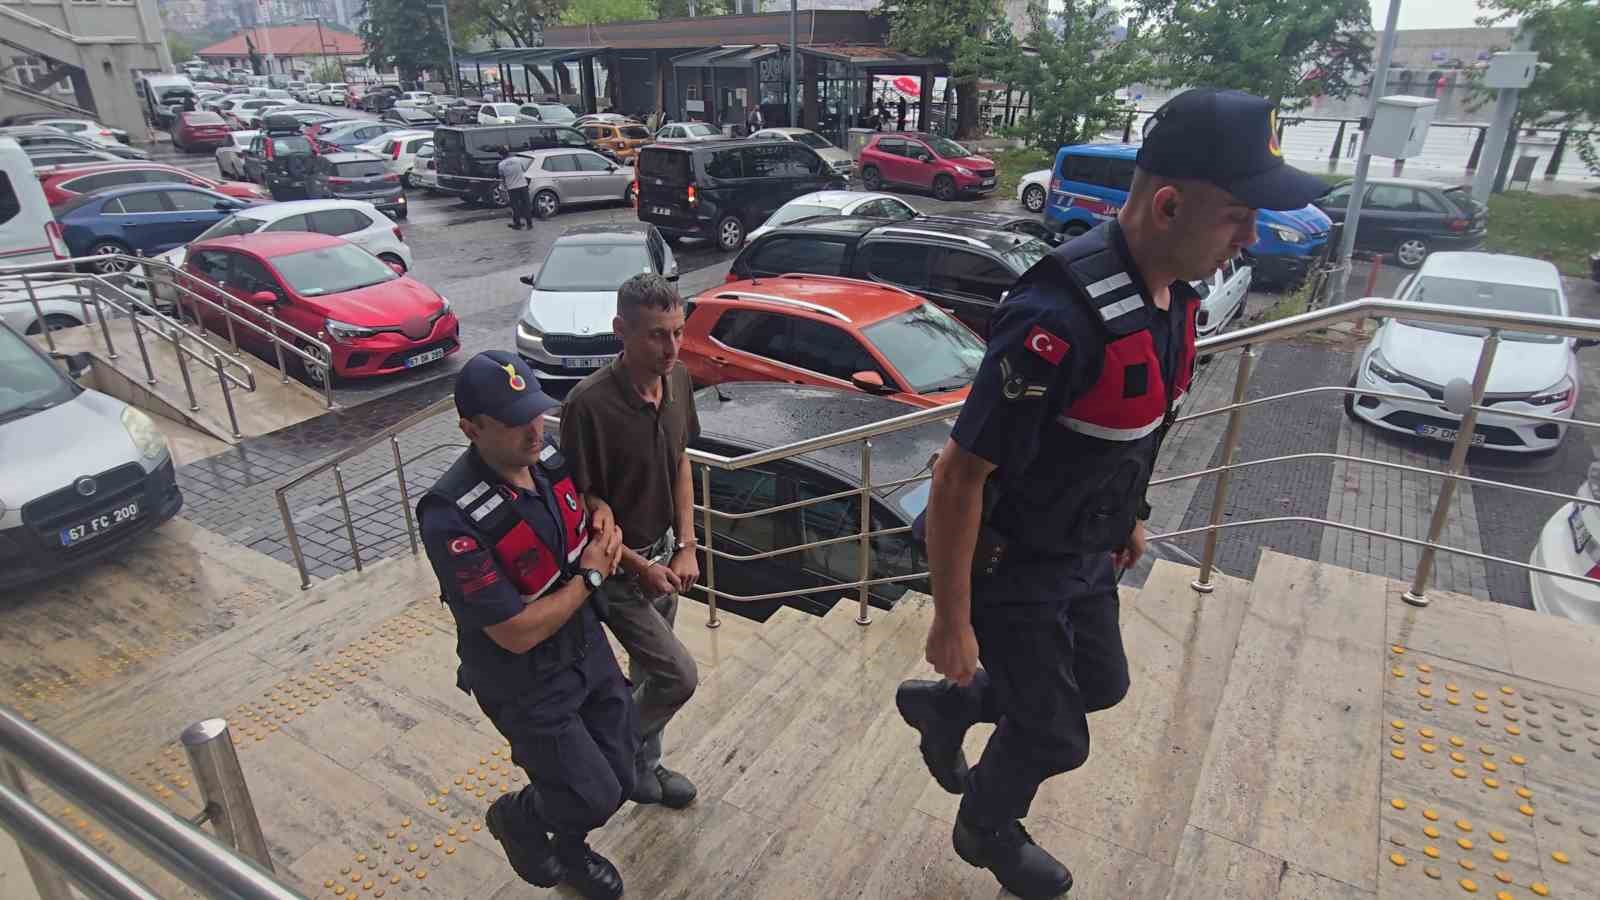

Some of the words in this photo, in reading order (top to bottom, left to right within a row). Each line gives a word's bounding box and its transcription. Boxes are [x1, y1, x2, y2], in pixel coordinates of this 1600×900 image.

[69, 525, 85, 540] 67
[91, 516, 109, 531] FC
[113, 503, 137, 522] 200
